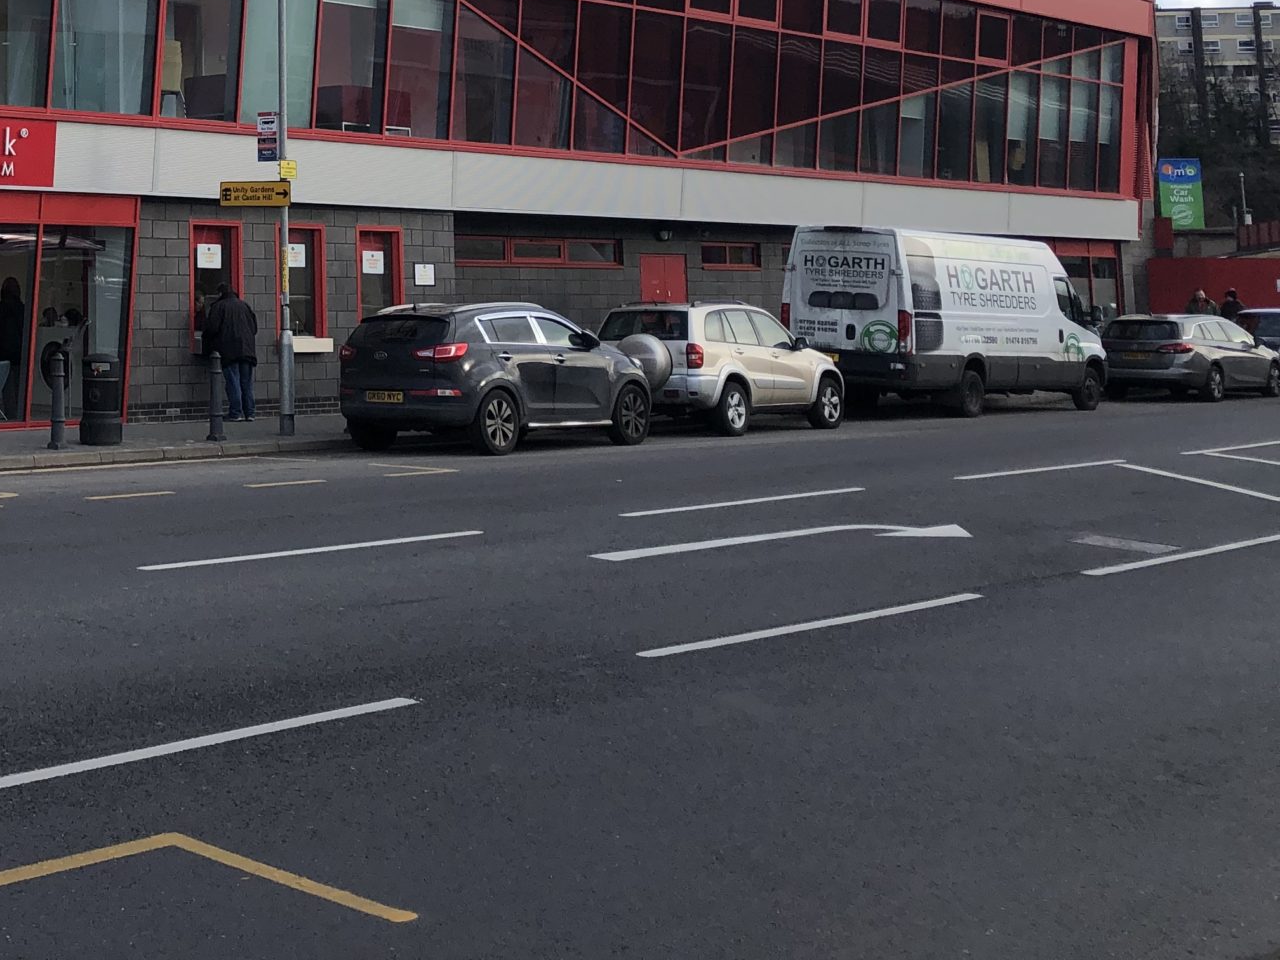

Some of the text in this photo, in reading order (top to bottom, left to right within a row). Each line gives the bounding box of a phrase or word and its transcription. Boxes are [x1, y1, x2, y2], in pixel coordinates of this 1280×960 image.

[1168, 165, 1195, 176] imo
[233, 186, 248, 195] Unity
[1170, 195, 1194, 203] Wash
[804, 254, 885, 270] HOGARTH
[804, 268, 884, 279] TYRE SHREDDERS
[946, 264, 1036, 293] HOGARTH
[950, 291, 1037, 310] TYRE SHREDDERS
[386, 392, 402, 401] NYC
